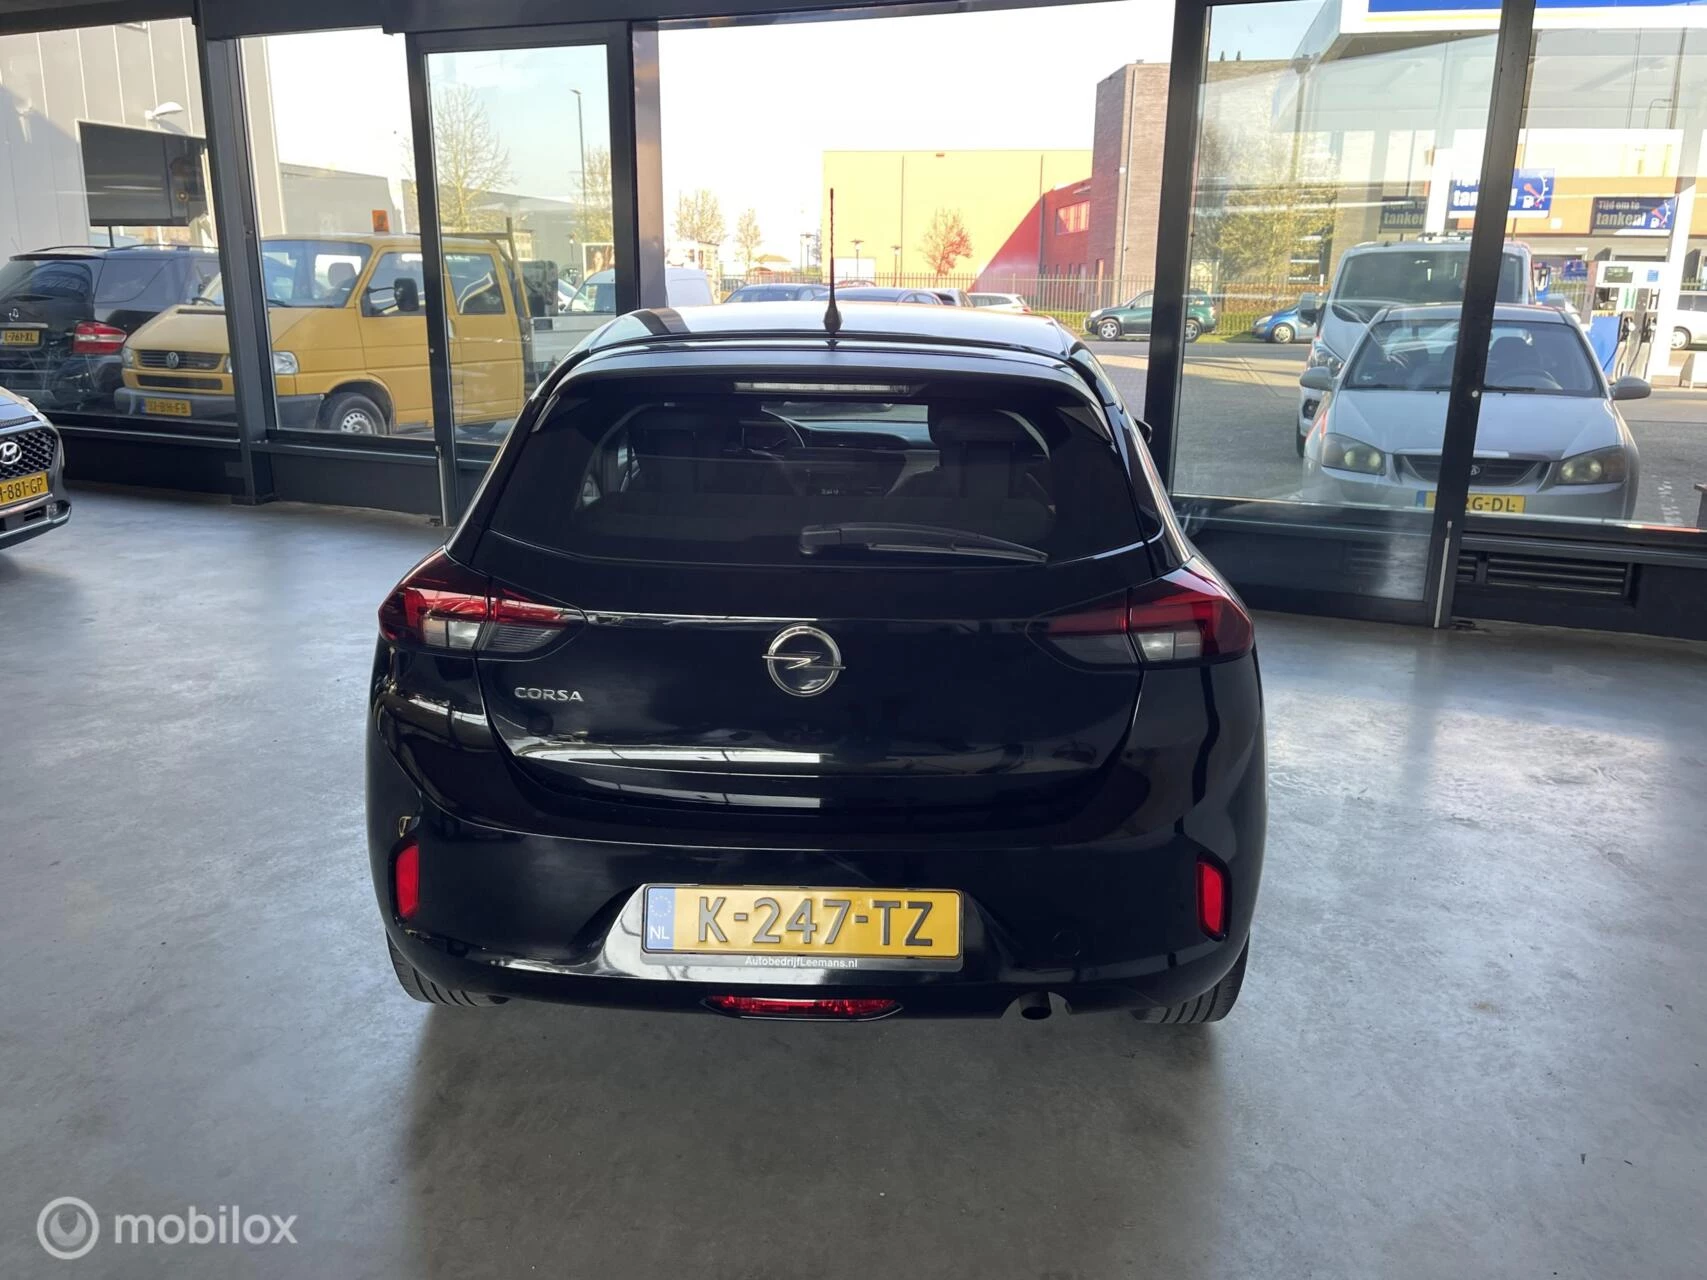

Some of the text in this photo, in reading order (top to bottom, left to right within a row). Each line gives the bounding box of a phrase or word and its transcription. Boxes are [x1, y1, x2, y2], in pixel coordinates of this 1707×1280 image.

[514, 687, 584, 702] CORSA
[650, 896, 934, 947] NL K-247-TZ
[745, 956, 858, 968] AutobedrijfLeemans.nl
